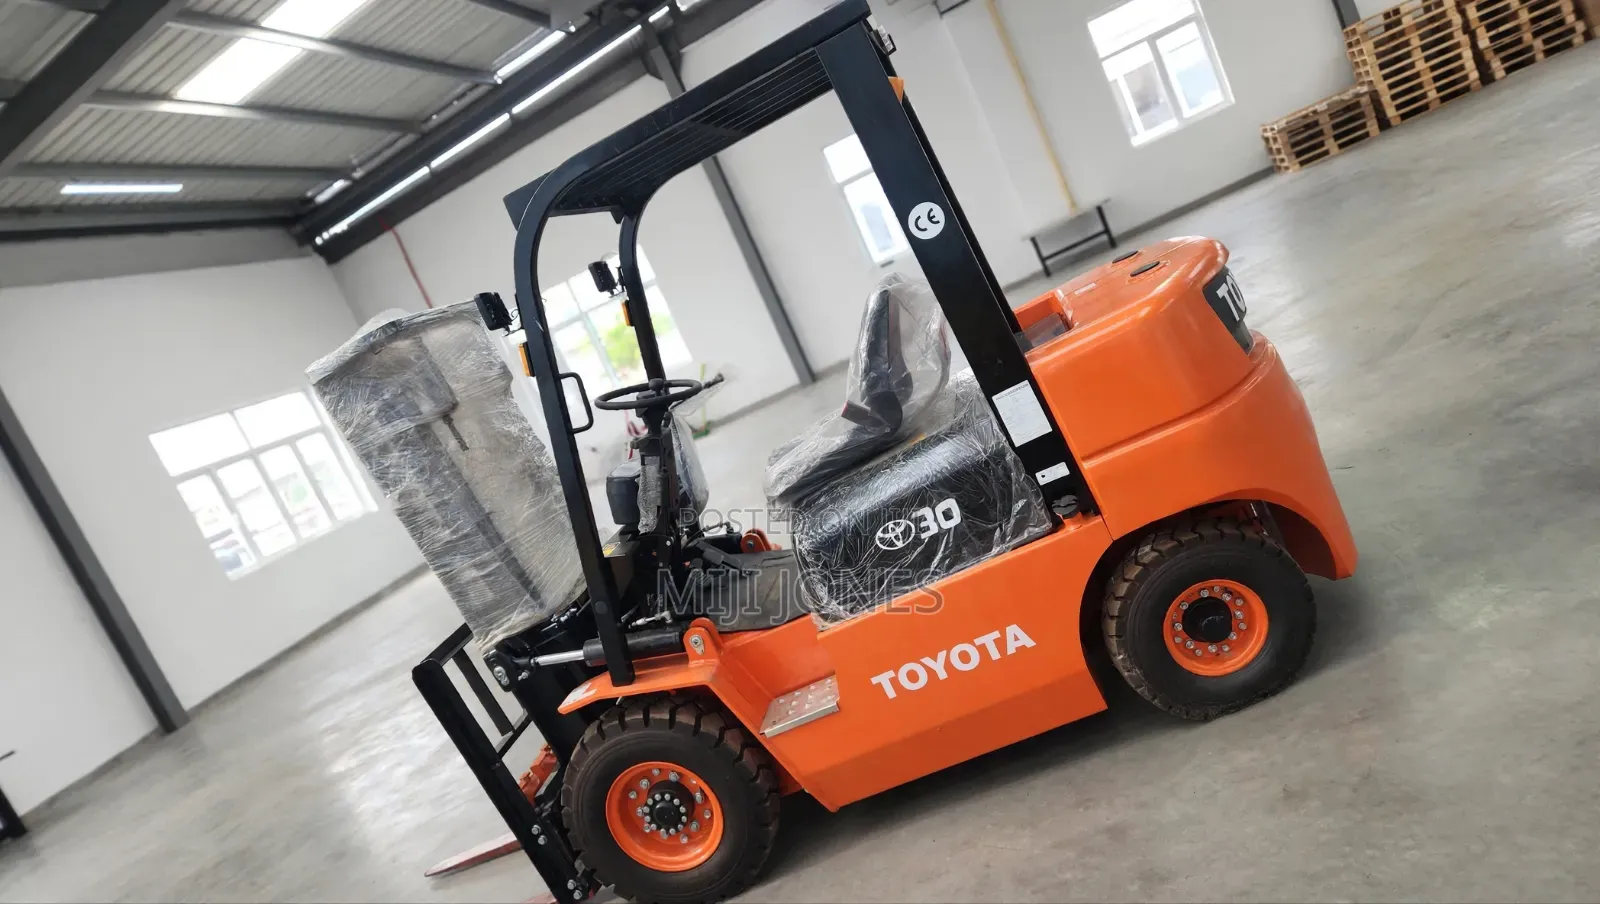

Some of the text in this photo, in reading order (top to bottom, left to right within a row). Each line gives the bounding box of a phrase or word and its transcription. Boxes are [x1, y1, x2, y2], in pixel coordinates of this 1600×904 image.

[914, 207, 940, 232] CE
[1216, 273, 1247, 322] TO
[911, 498, 961, 540] 30
[870, 623, 1036, 699] TOYOTA
